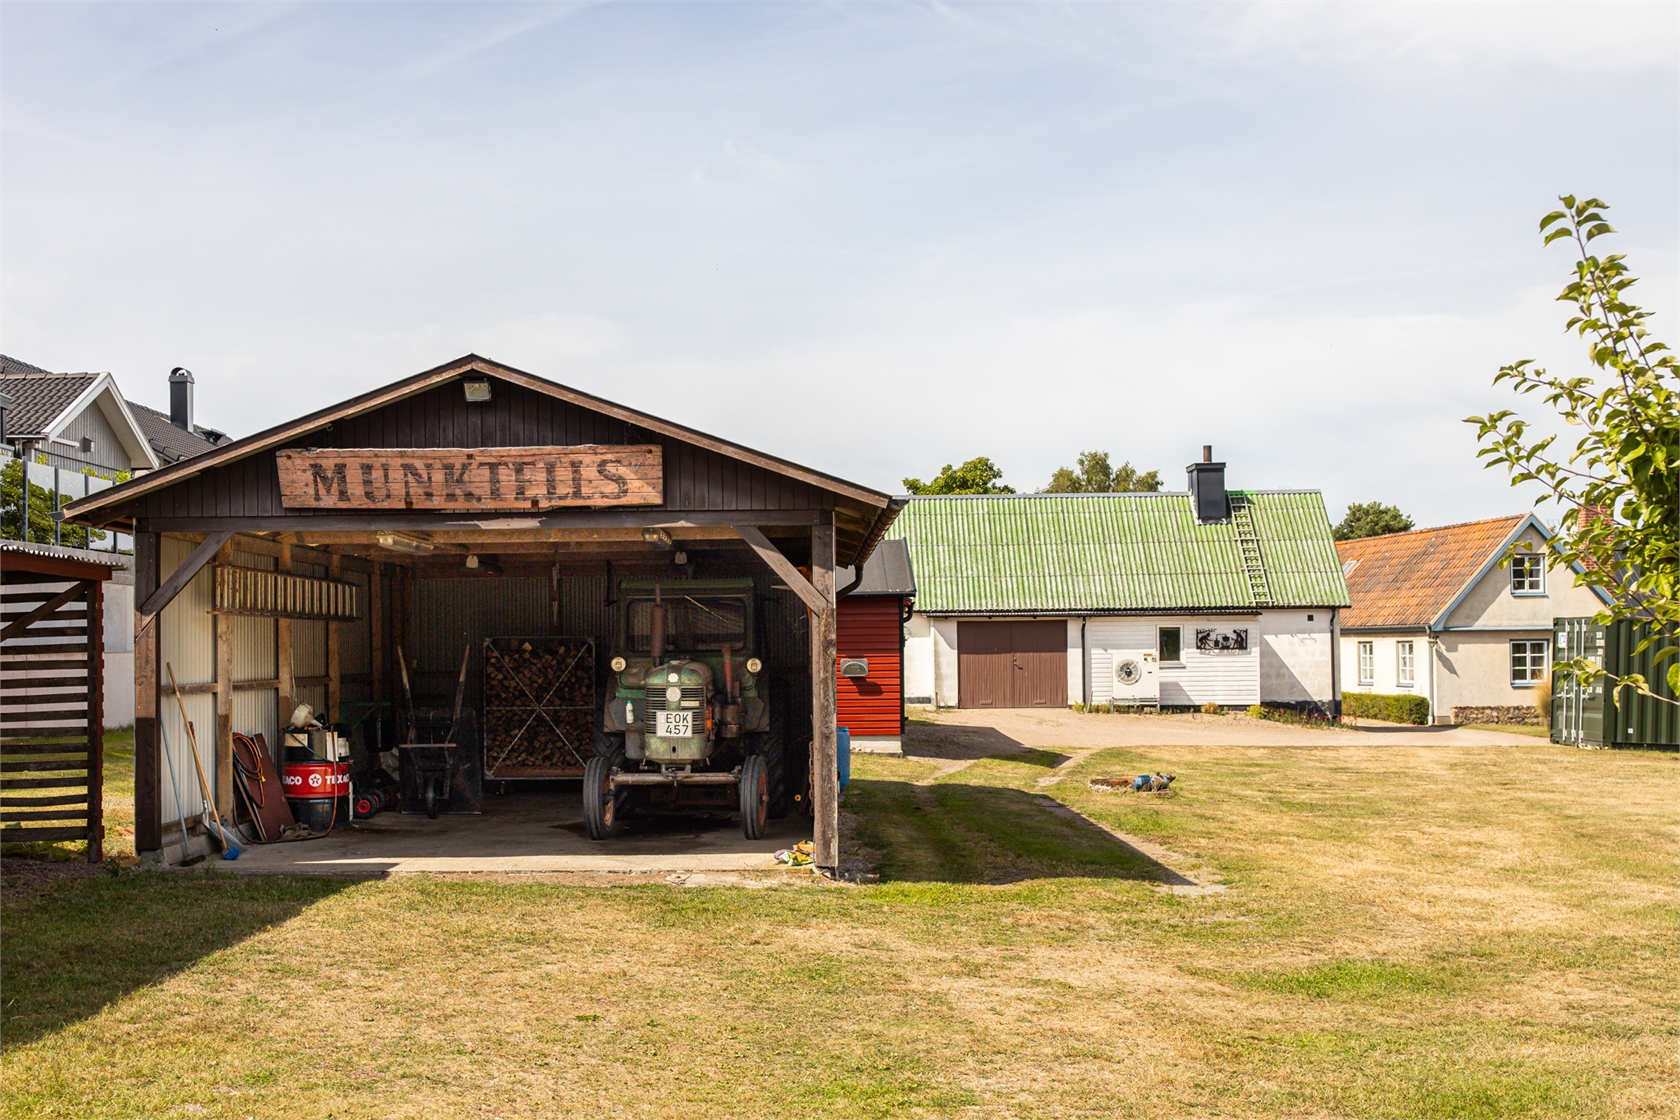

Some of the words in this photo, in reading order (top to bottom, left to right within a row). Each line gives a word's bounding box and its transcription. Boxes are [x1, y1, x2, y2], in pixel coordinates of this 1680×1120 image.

[311, 458, 629, 503] MUNKTELLS
[666, 713, 689, 724] EOK
[666, 725, 689, 735] 457
